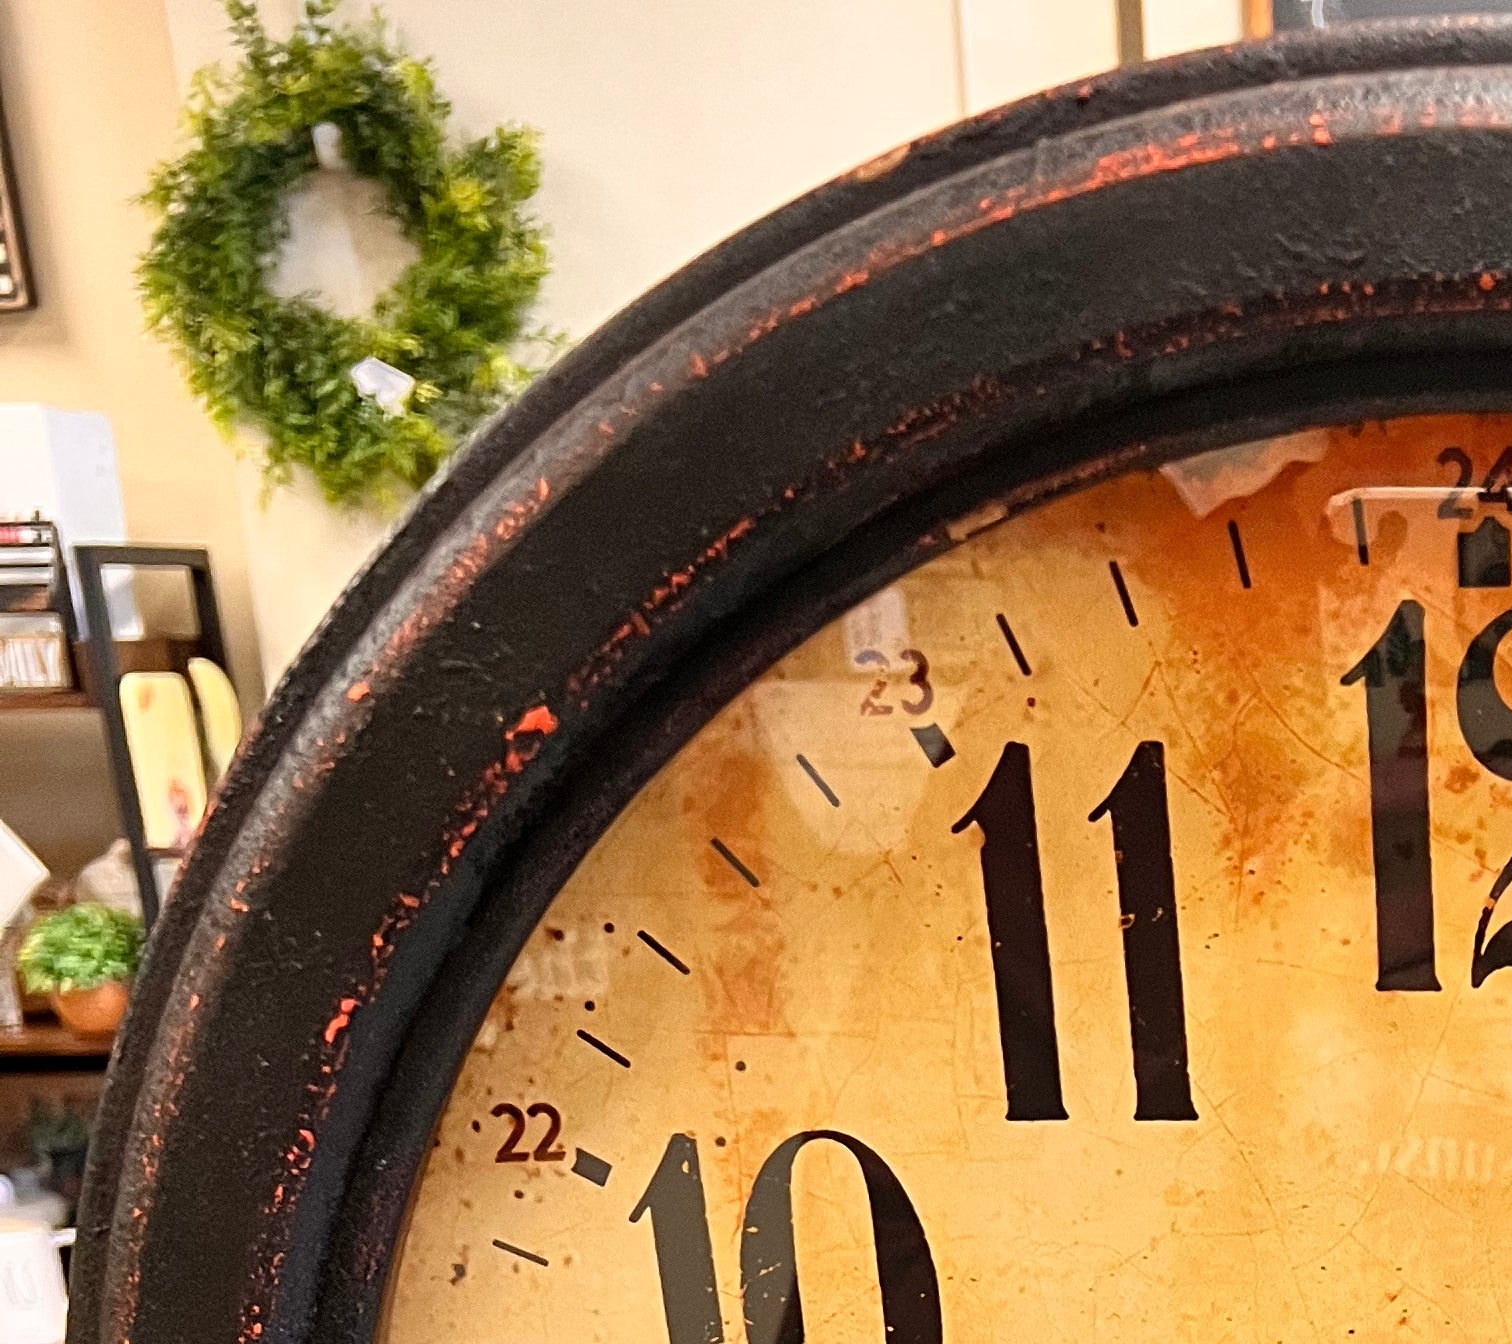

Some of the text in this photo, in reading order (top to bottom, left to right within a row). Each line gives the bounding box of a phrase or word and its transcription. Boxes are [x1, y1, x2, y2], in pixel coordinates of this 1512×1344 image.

[855, 649, 932, 716] 23
[951, 741, 1199, 1121] 11
[491, 1102, 566, 1163] 22
